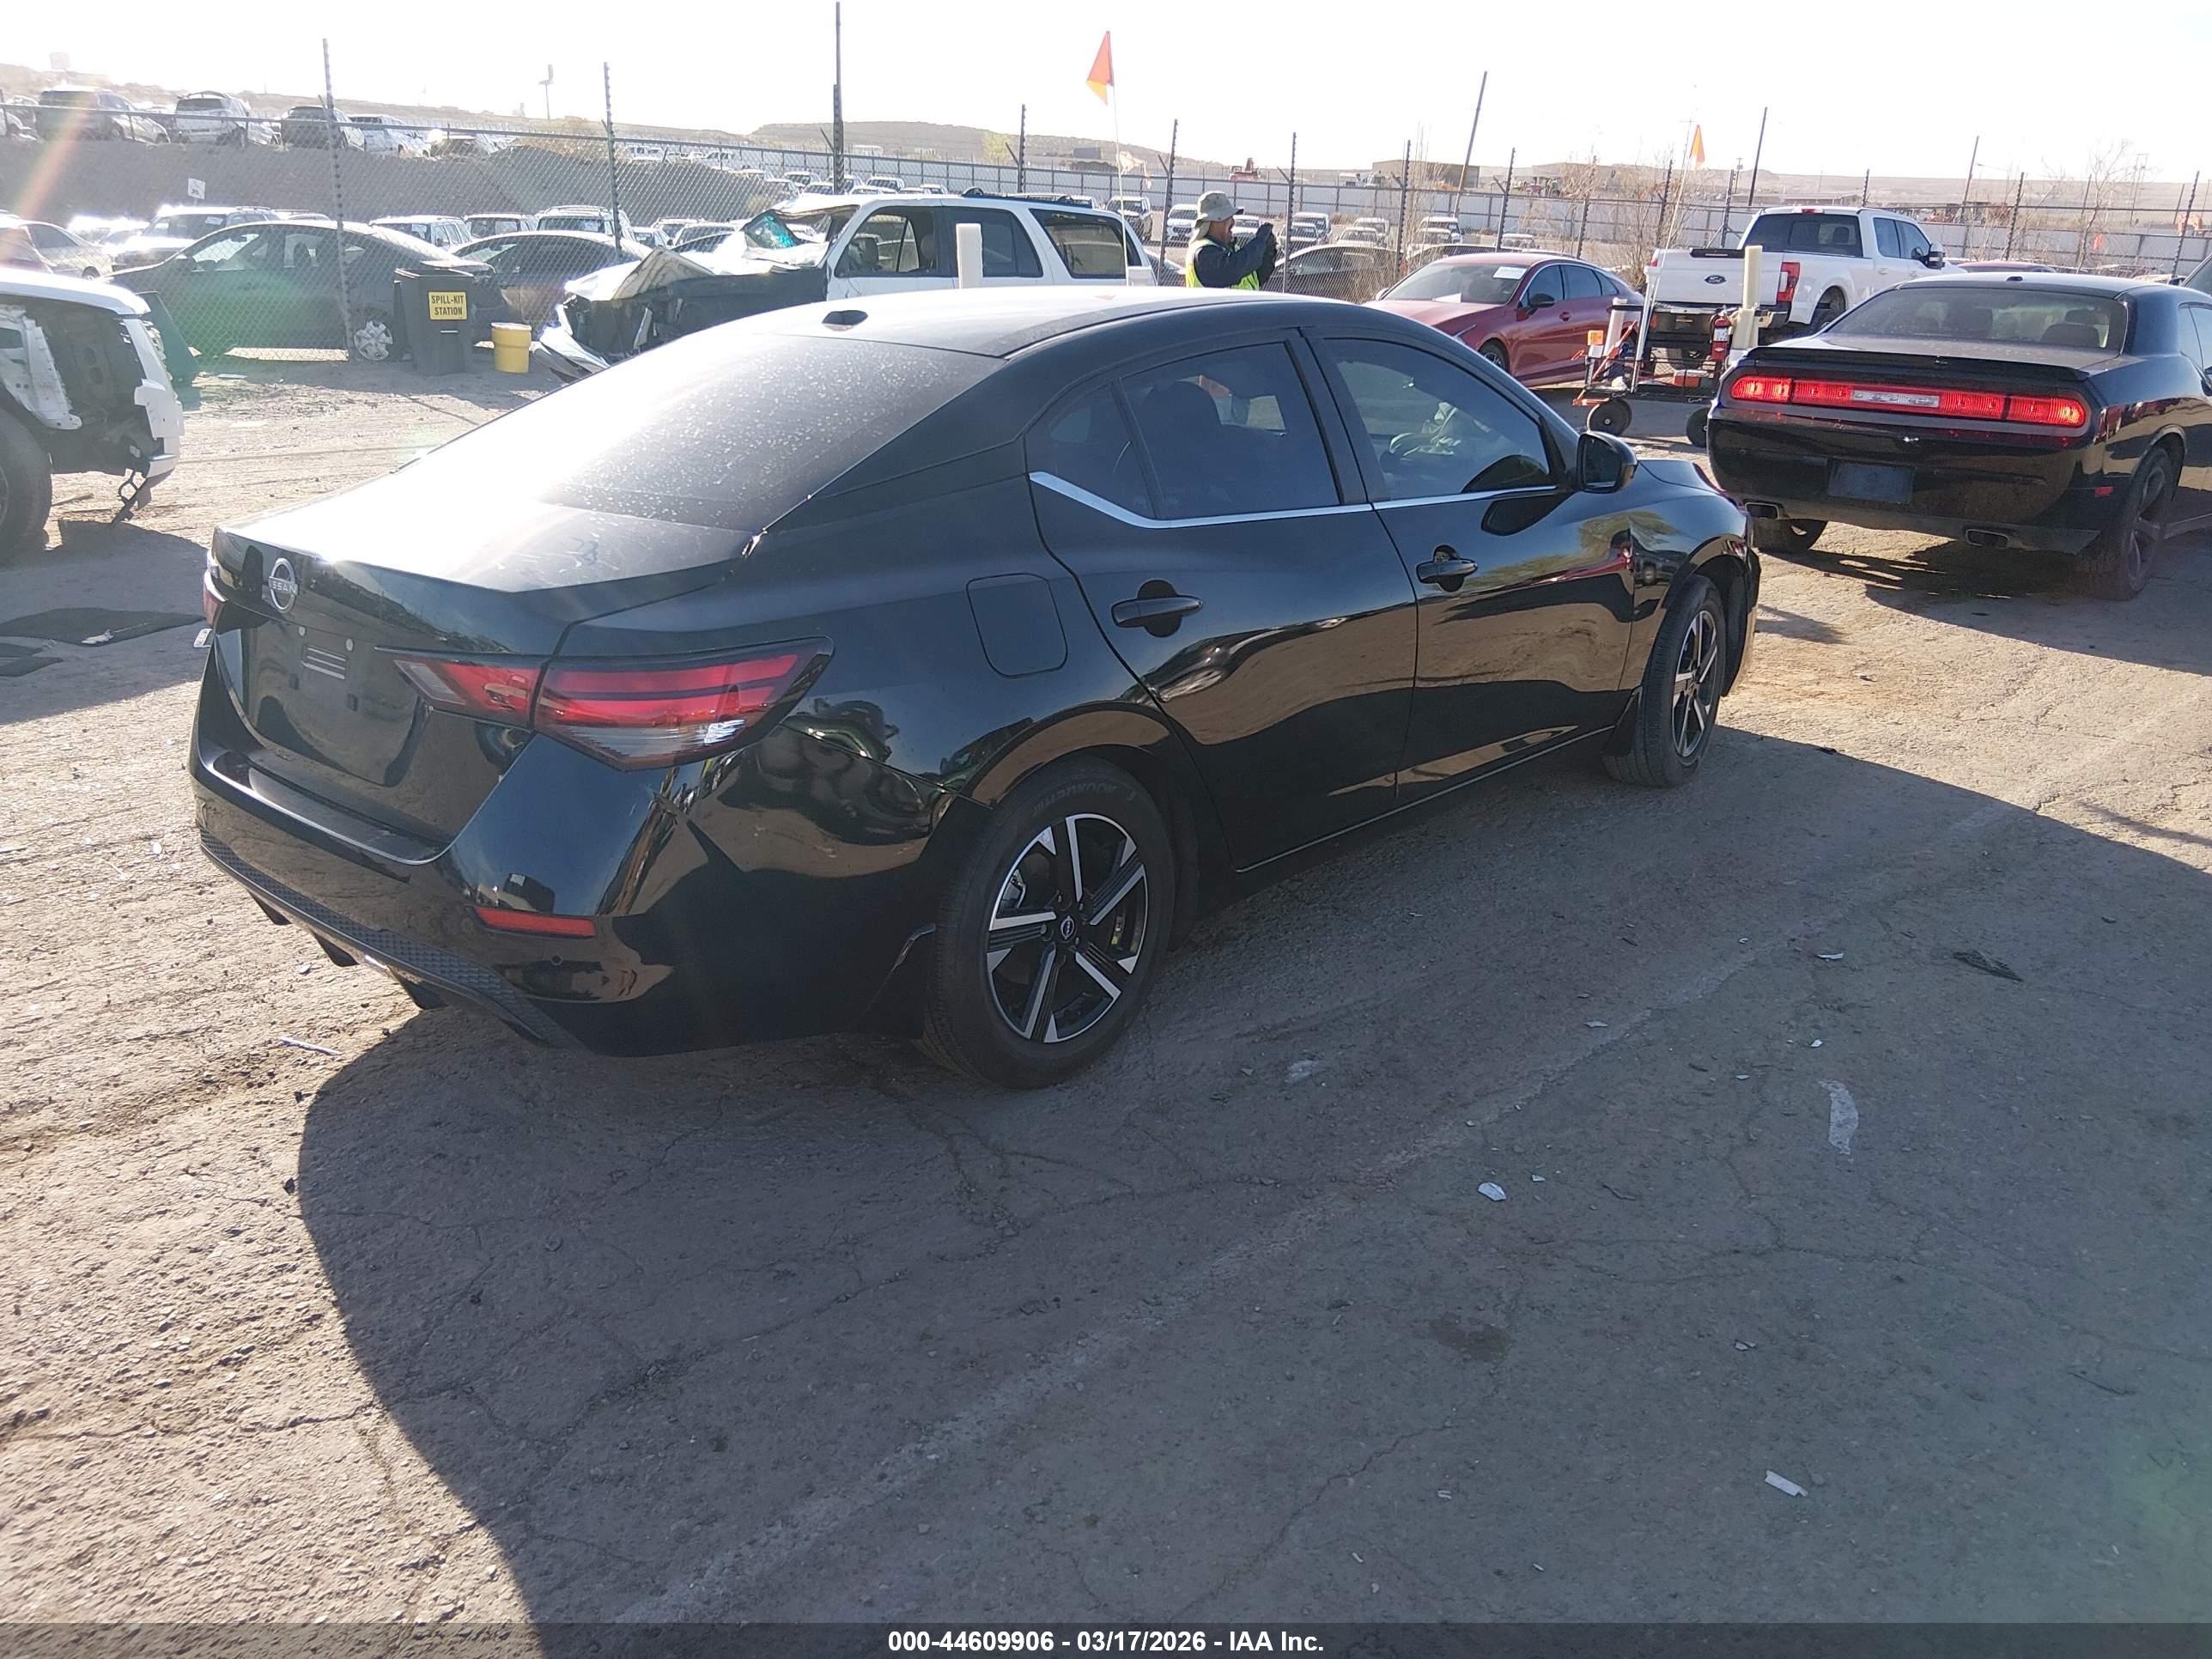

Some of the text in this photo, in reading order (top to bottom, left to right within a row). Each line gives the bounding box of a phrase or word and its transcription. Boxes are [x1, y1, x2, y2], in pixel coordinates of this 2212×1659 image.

[431, 295, 465, 304] SPILL-KIT
[434, 307, 463, 316] STATION
[270, 579, 298, 595] SSAN
